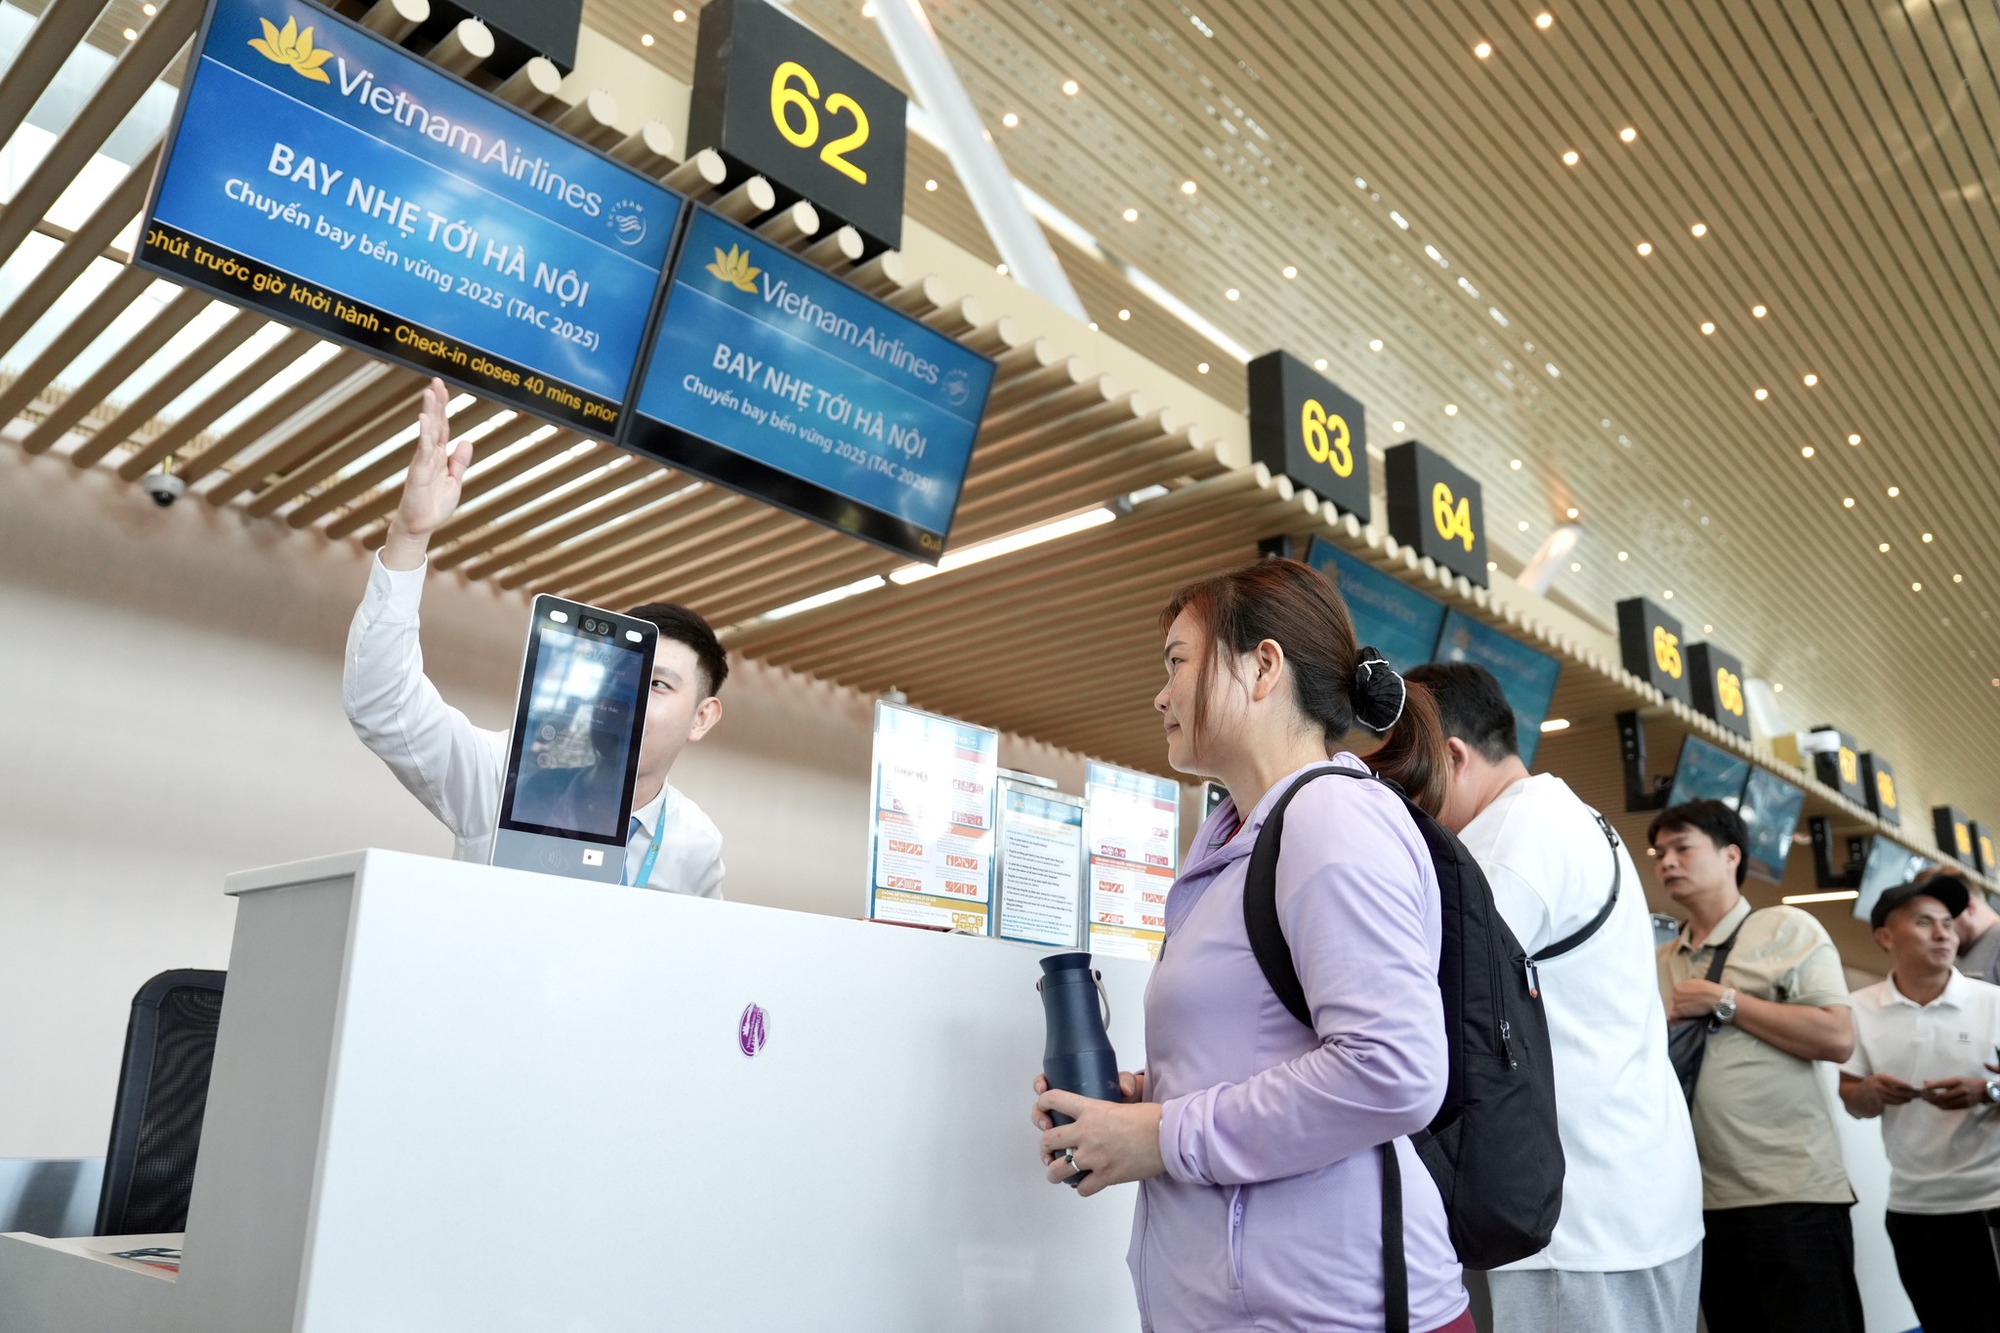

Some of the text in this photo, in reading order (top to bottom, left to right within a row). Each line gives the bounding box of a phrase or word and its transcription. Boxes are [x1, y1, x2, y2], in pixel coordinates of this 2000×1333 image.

[770, 61, 870, 185] 62
[224, 178, 600, 352] Chuyến bay bền vững 2025 (TAC 2025)
[267, 142, 590, 309] BAY NHẸ TỚI HÀ NỘI
[194, 246, 250, 282] trước
[252, 272, 287, 295] giờ
[289, 283, 332, 313] khởi
[333, 302, 380, 333] hành
[394, 324, 468, 366] Check-in
[470, 355, 521, 387] closes
[523, 376, 545, 395] 40
[546, 386, 582, 411] mins
[583, 399, 618, 423] prior
[682, 374, 739, 411] Chuyến
[741, 397, 769, 425] bay
[834, 439, 867, 465] 2025
[868, 454, 899, 478] (TAC
[712, 343, 928, 460] BAY NHẸ TỚI HÀ NỘI
[1302, 398, 1354, 478] 63
[1432, 481, 1475, 552] 64
[1653, 625, 1683, 680] 65
